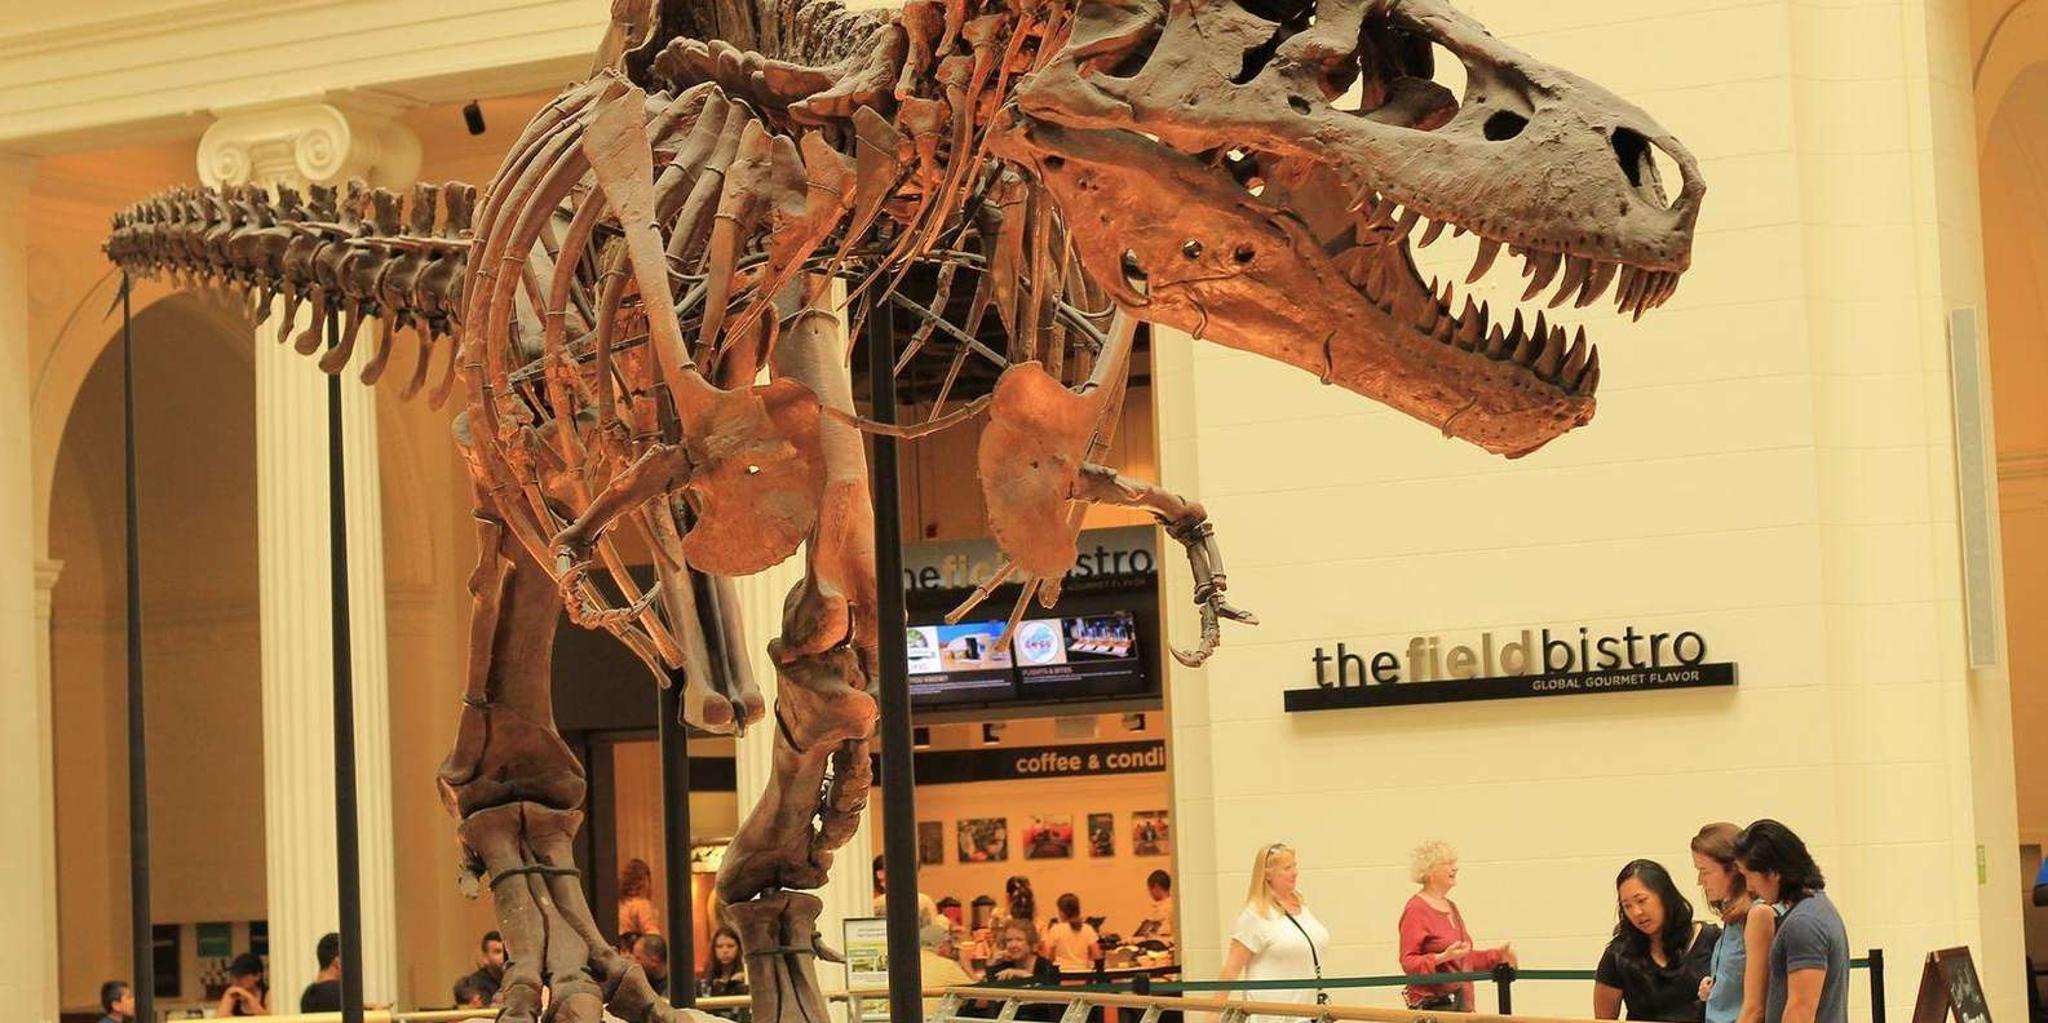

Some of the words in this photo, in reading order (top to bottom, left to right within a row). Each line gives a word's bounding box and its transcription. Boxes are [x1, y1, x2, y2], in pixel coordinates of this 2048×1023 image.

[1070, 545, 1153, 577] stro
[1532, 679, 1581, 691] GLOBAL
[1585, 674, 1647, 688] GOURMET
[1650, 671, 1700, 684] FLAVOR
[1016, 752, 1082, 773] coffee
[1088, 753, 1101, 770] &
